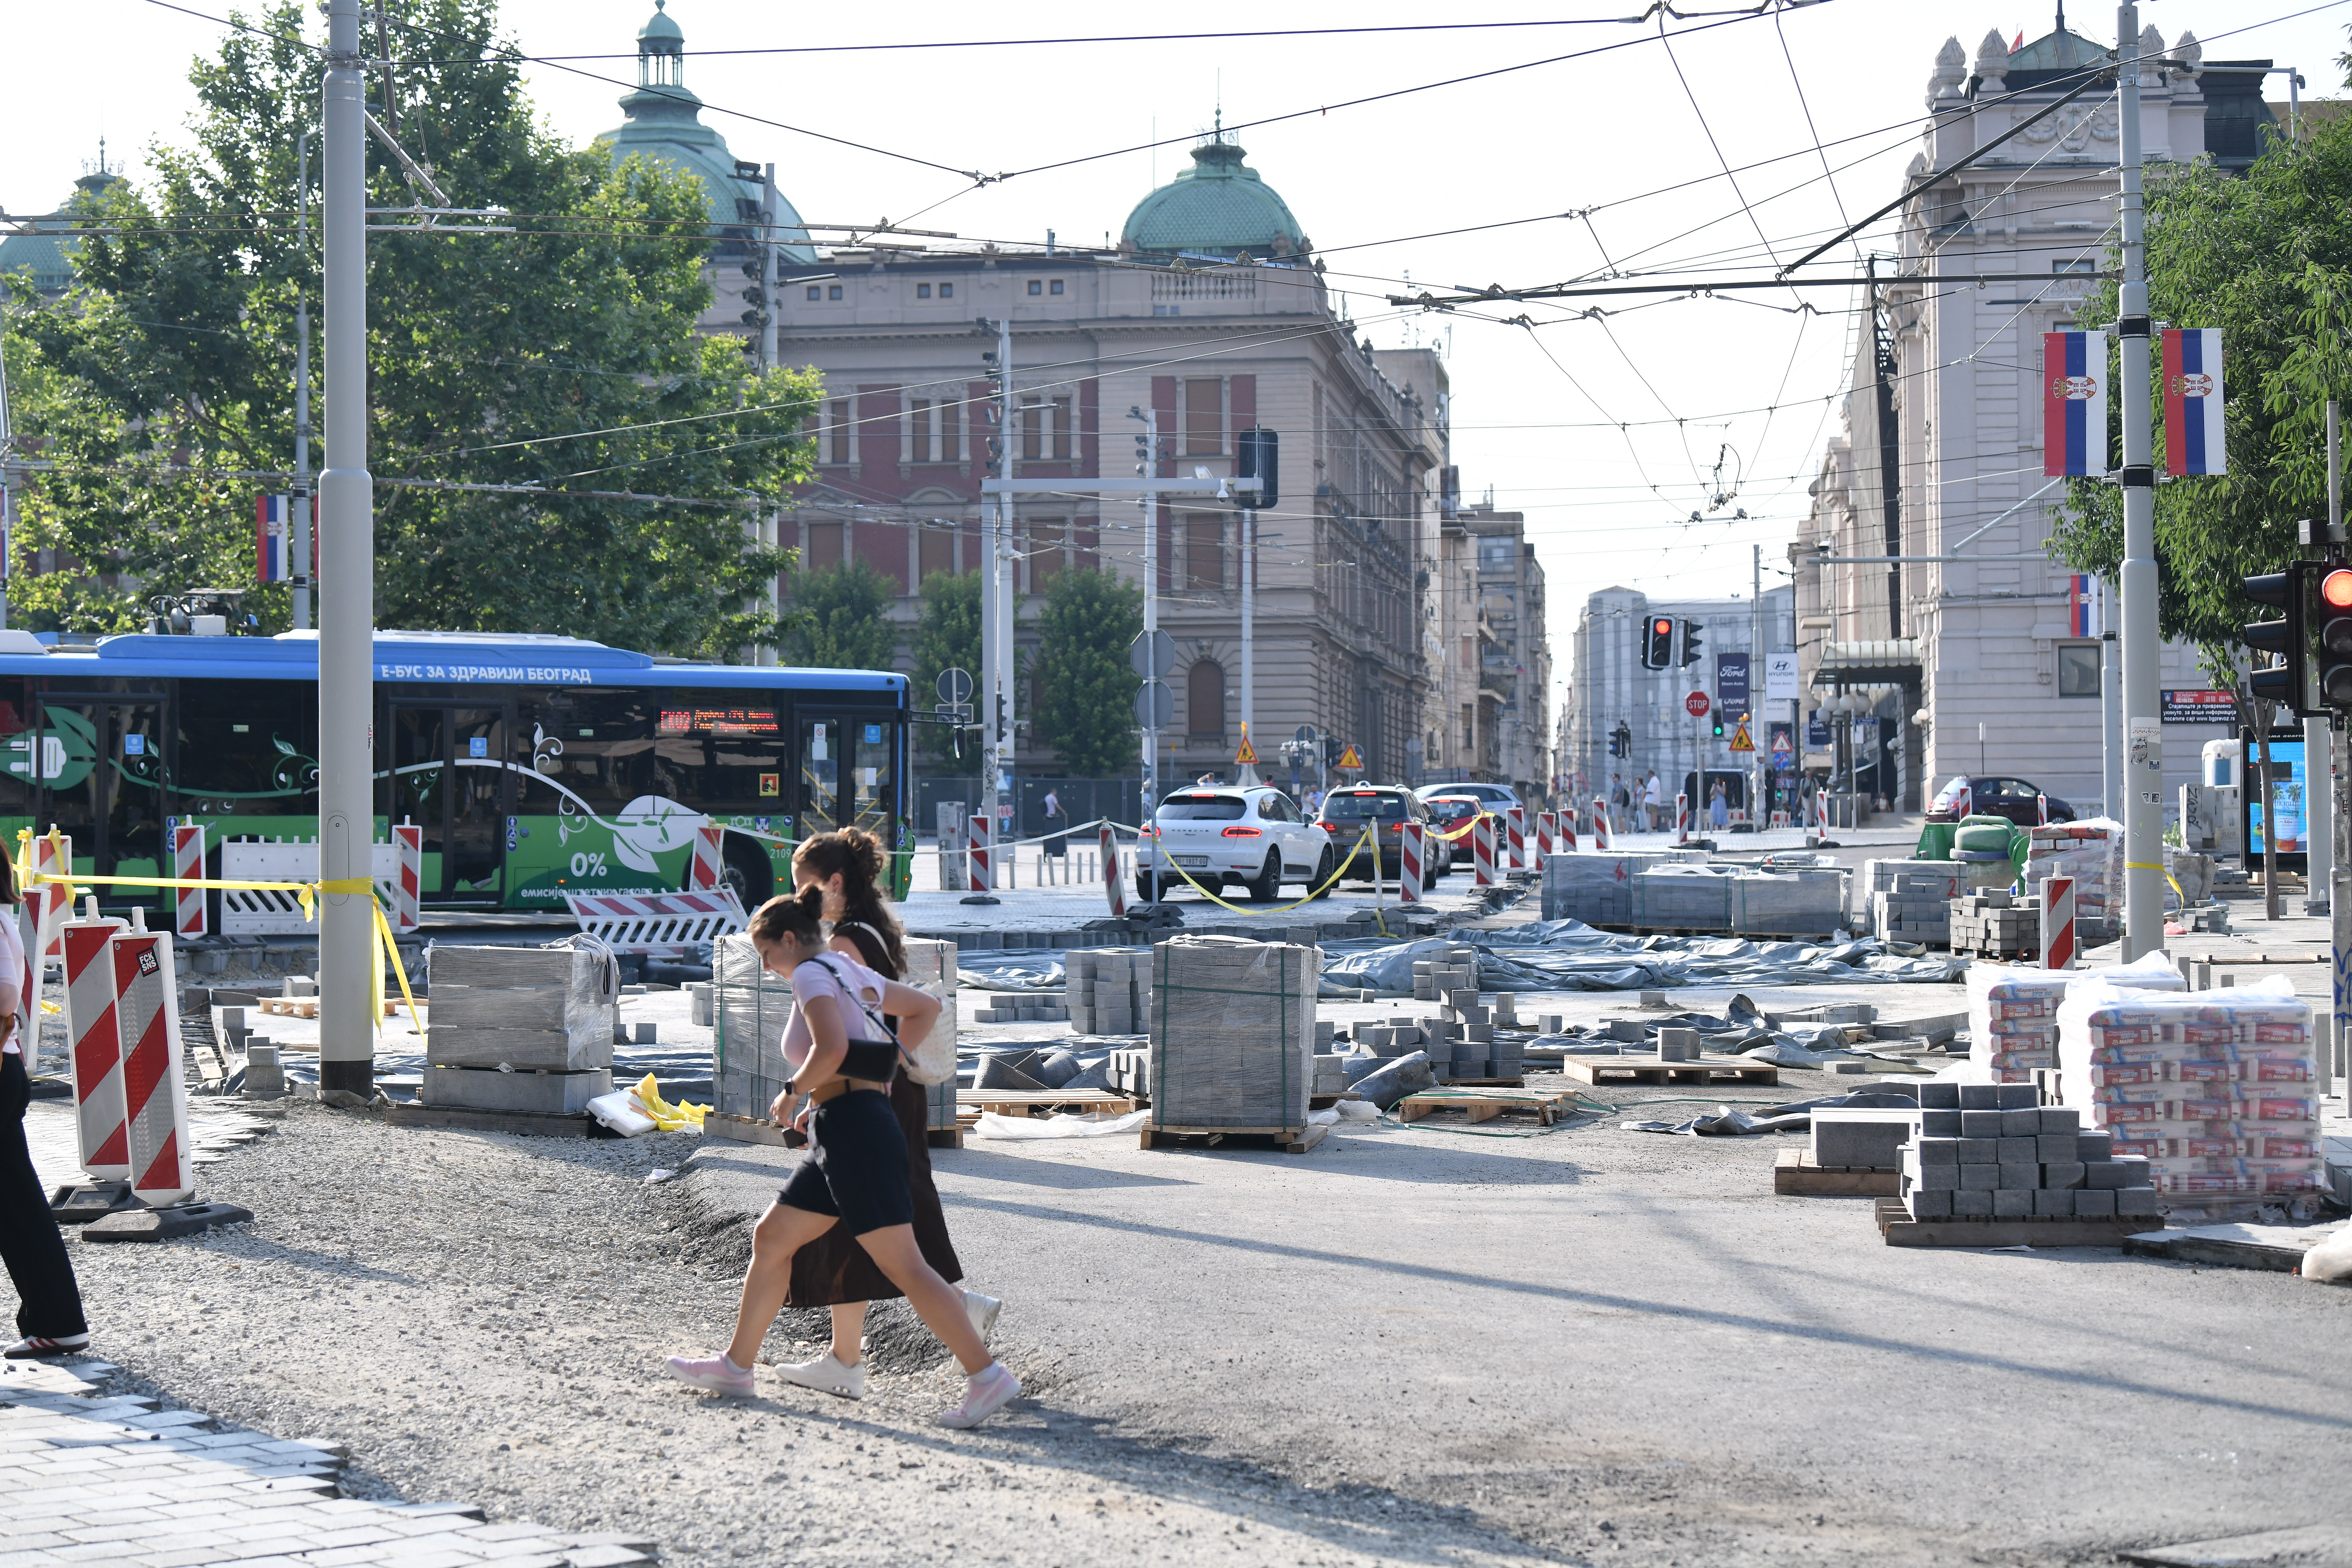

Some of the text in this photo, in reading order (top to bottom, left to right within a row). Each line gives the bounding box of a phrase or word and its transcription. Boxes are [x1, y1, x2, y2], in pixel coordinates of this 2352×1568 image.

[381, 665, 591, 684] Е-БУС ЗА ЗДРАВИЈИ БЕОГРАД
[1720, 665, 1746, 677] Ford
[1689, 700, 1707, 709] STOP
[770, 849, 791, 858] 2109
[571, 852, 607, 877] 0%
[1947, 878, 1958, 897] 2
[139, 952, 154, 964] FCK
[142, 959, 156, 971] SNS
